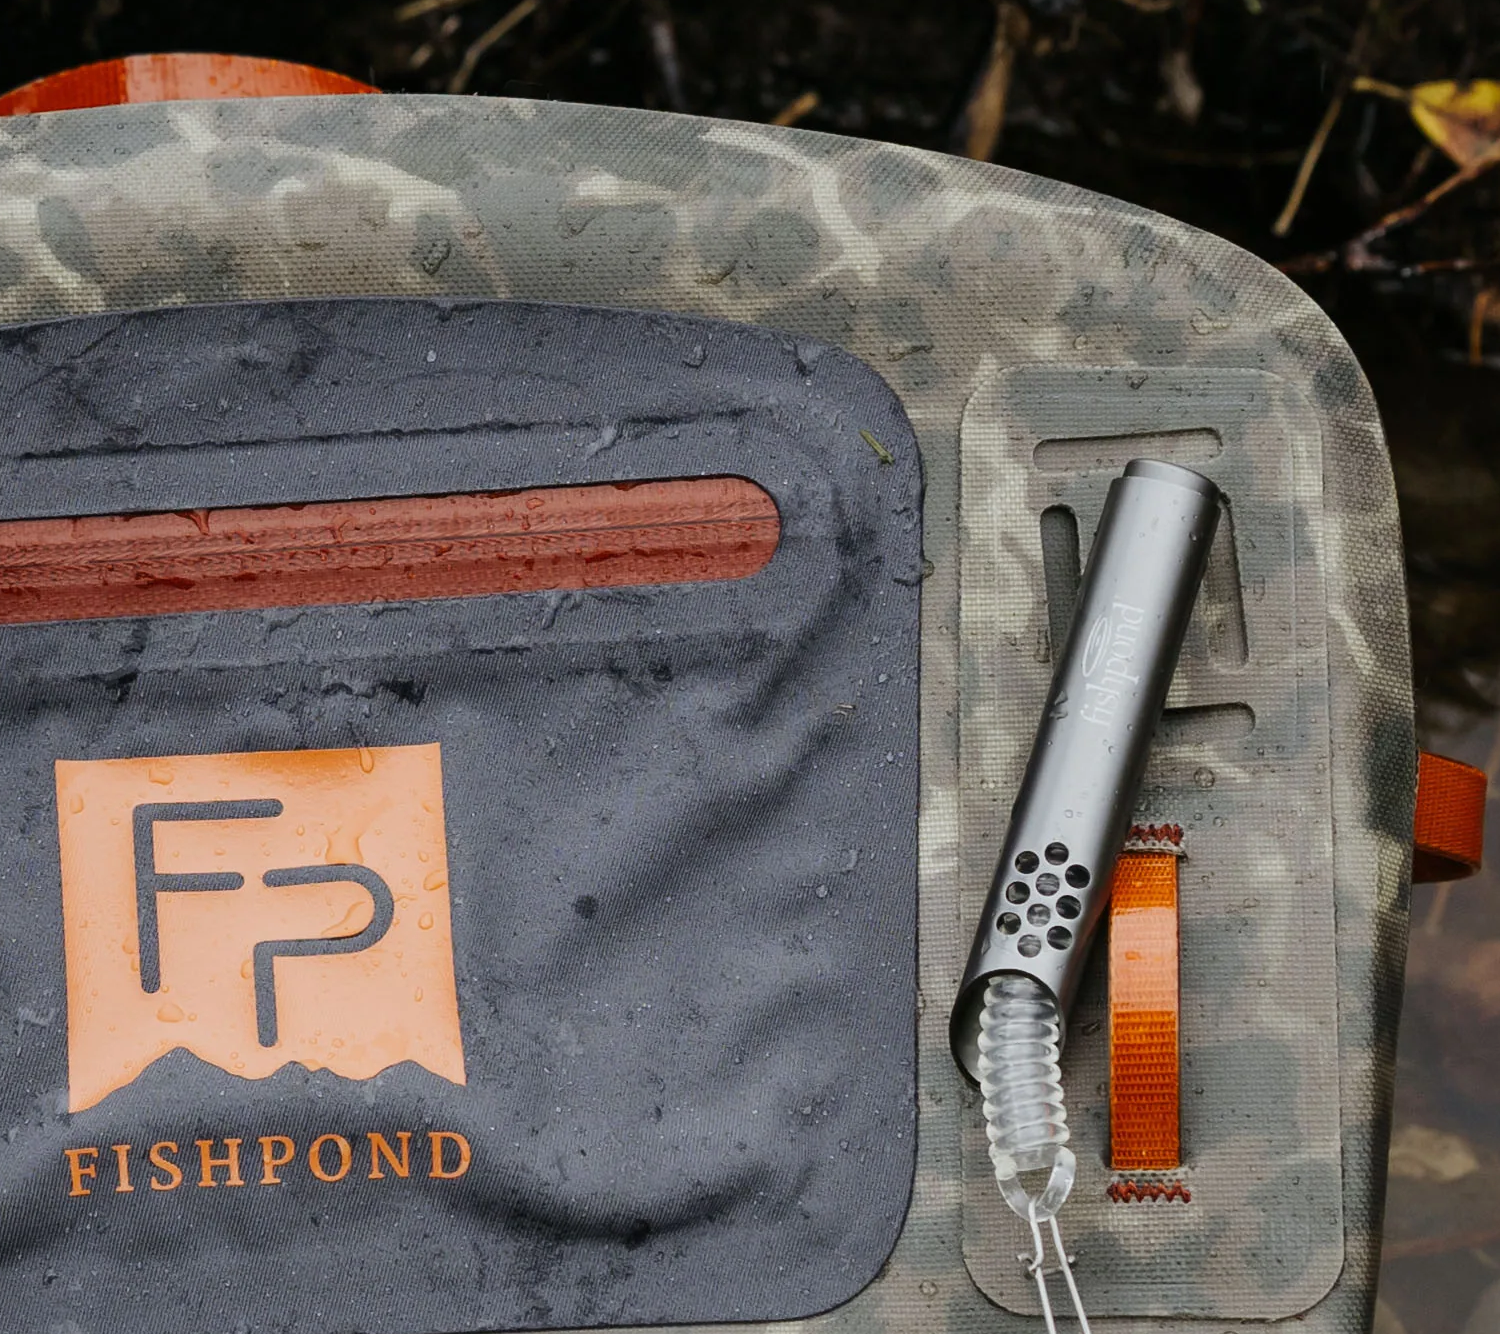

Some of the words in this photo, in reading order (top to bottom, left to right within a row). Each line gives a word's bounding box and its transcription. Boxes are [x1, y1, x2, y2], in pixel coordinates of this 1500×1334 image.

[1080, 602, 1145, 726] fishpond
[133, 797, 395, 1049] FP
[64, 1131, 471, 1197] FISHPOND
